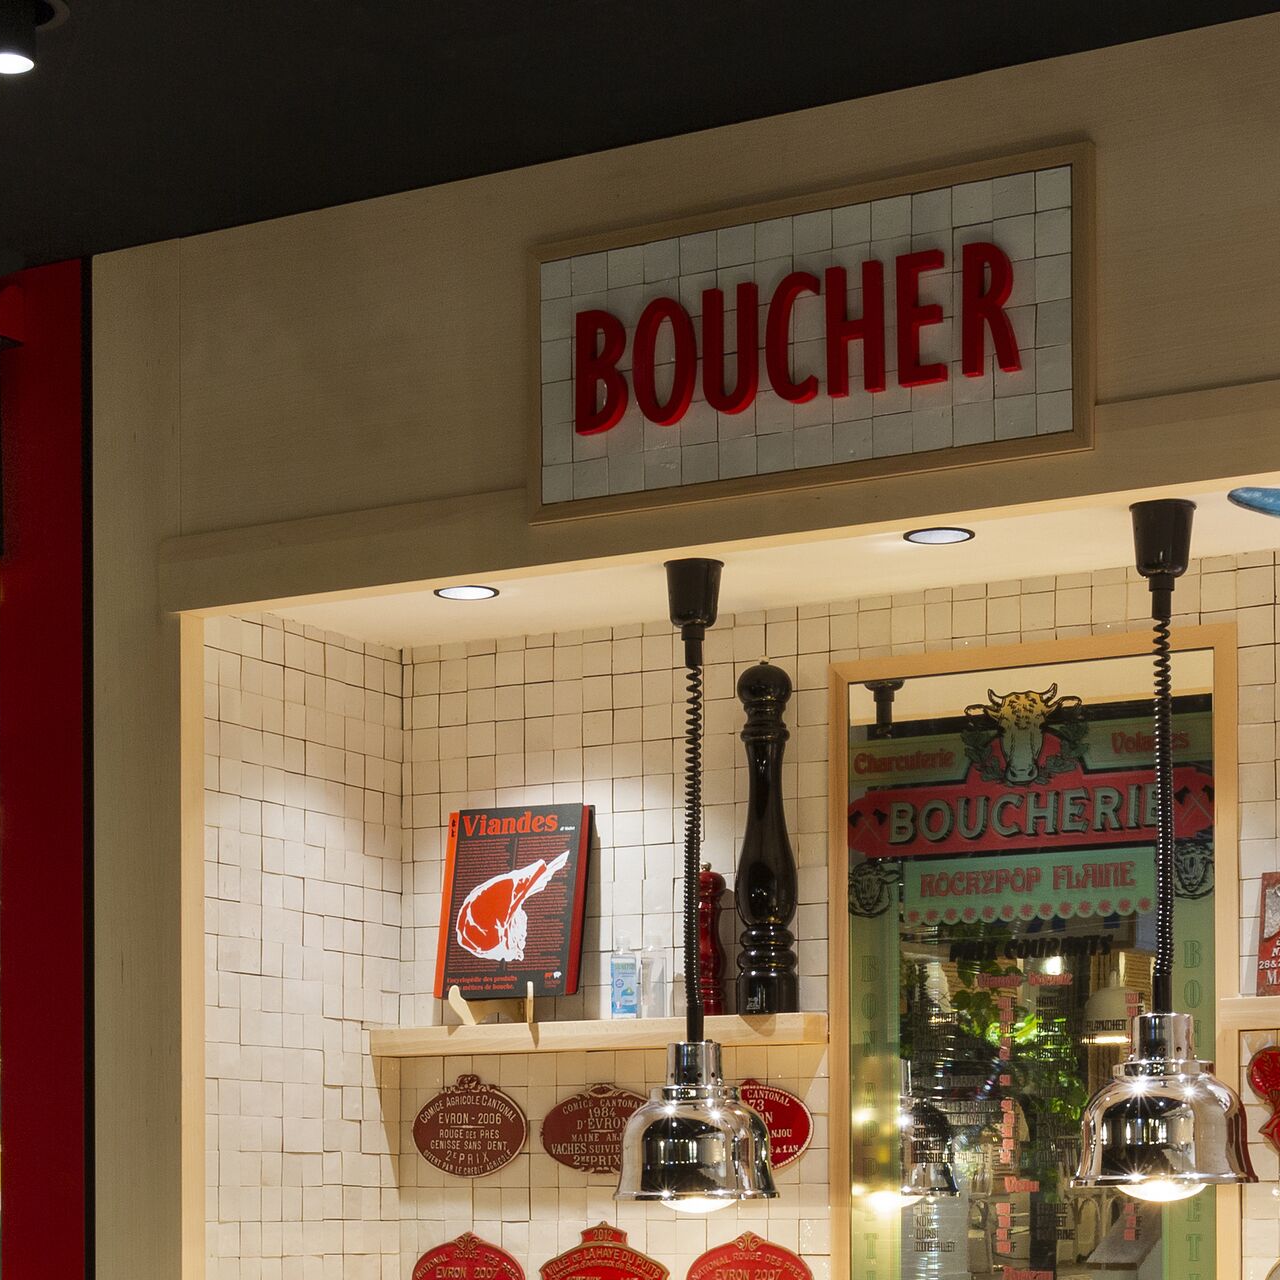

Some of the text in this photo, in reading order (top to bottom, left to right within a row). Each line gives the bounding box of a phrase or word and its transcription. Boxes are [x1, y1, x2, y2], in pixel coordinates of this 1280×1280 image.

[575, 242, 1021, 436] BOUCHER
[1111, 729, 1190, 754] Volaes
[854, 747, 955, 776] Charcuterie
[463, 811, 559, 837] Viandes
[920, 860, 1137, 898] ROCKYPOP FLAINE
[747, 1090, 790, 1106] CANTONAL
[748, 1099, 765, 1111] 73
[419, 1094, 517, 1124] COMICE AGRICOLE CANTONAL
[562, 1100, 593, 1115] COMICE
[589, 1107, 616, 1118] 1984
[438, 1112, 469, 1125] EVRON
[477, 1112, 502, 1125] 2006
[439, 1129, 464, 1139] ROUGE
[480, 1129, 500, 1139] PRES
[571, 1132, 622, 1142] MAINE ANJ
[771, 1129, 792, 1138] NJOU
[430, 1140, 461, 1150] GENISSE
[464, 1140, 482, 1150] SANS
[551, 1142, 621, 1155] VACHES SUIVIE
[423, 1149, 442, 1166] OFFERT
[442, 1162, 453, 1171] PAR
[455, 1166, 462, 1174] LE
[486, 1149, 513, 1171] AGRICOLE
[458, 1151, 490, 1165] PRIX
[590, 1155, 620, 1166] PRIX
[592, 1229, 613, 1240] 2012
[415, 1253, 449, 1280] NATIONAL
[546, 1257, 570, 1276] VILLE
[584, 1248, 596, 1259] LA
[596, 1247, 621, 1259] HAYE
[622, 1250, 635, 1264] DU
[635, 1257, 661, 1277] PUITS
[733, 1252, 762, 1261] ROUGE
[764, 1254, 783, 1267] DES
[436, 1266, 499, 1279] EVRON 2007
[715, 1268, 783, 1280] EVRON 2007
